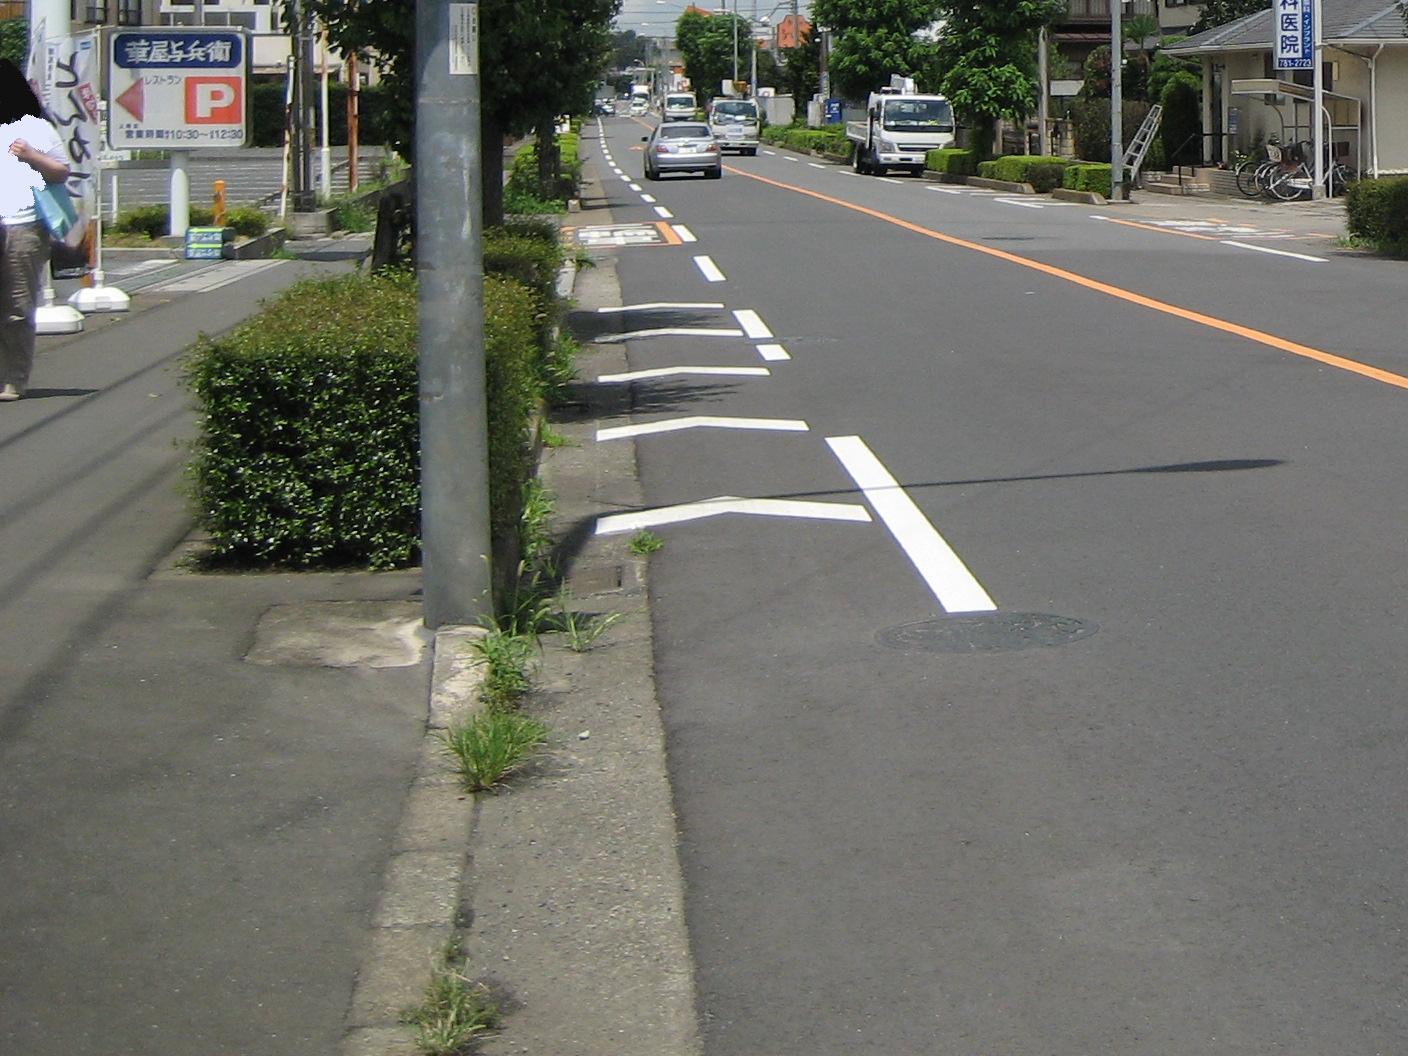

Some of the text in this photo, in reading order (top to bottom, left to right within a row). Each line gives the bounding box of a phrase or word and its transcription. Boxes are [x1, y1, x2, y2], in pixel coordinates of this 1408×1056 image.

[125, 39, 232, 63] 華屋与兵衛
[144, 75, 182, 86] レストラン
[195, 83, 235, 118] P
